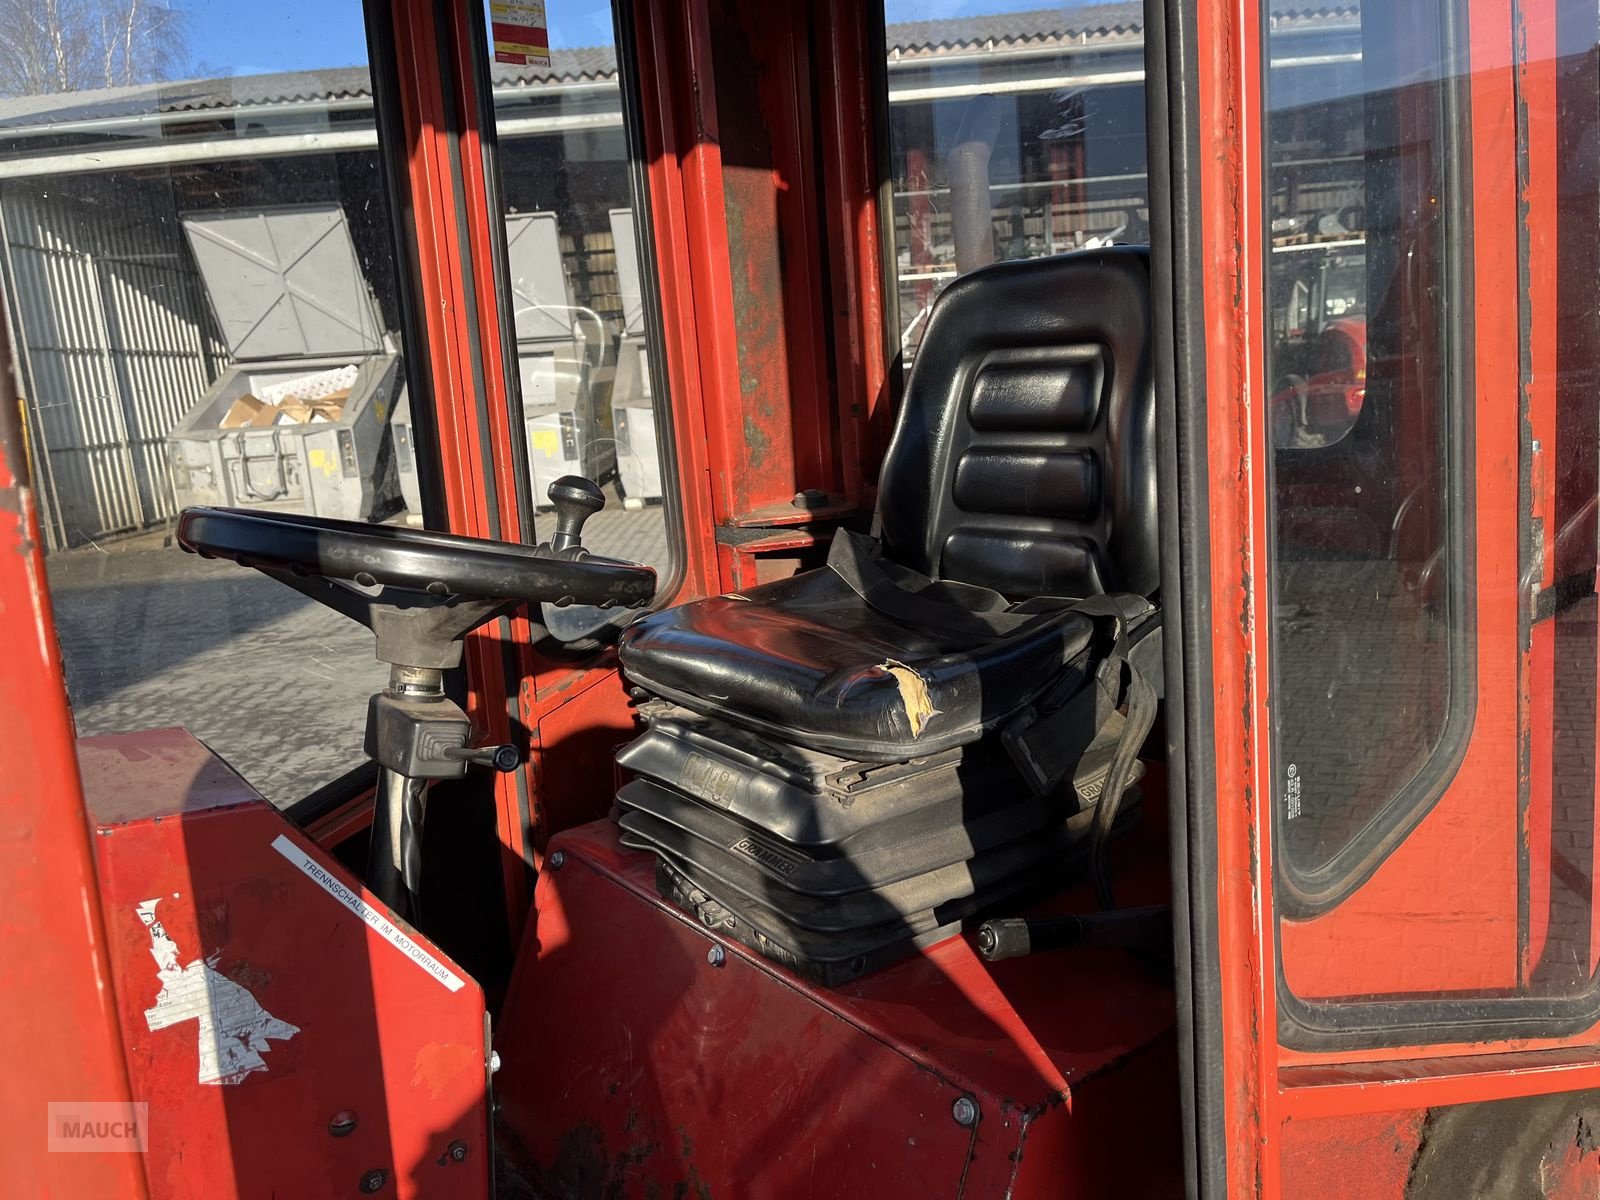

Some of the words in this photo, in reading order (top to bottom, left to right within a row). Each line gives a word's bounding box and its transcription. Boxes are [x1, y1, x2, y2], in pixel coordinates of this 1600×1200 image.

[738, 839, 795, 876] GRAMMER
[303, 859, 379, 926] TRENNSCHALTER
[380, 923, 393, 936] IM
[393, 934, 449, 981] MOTORRAUM
